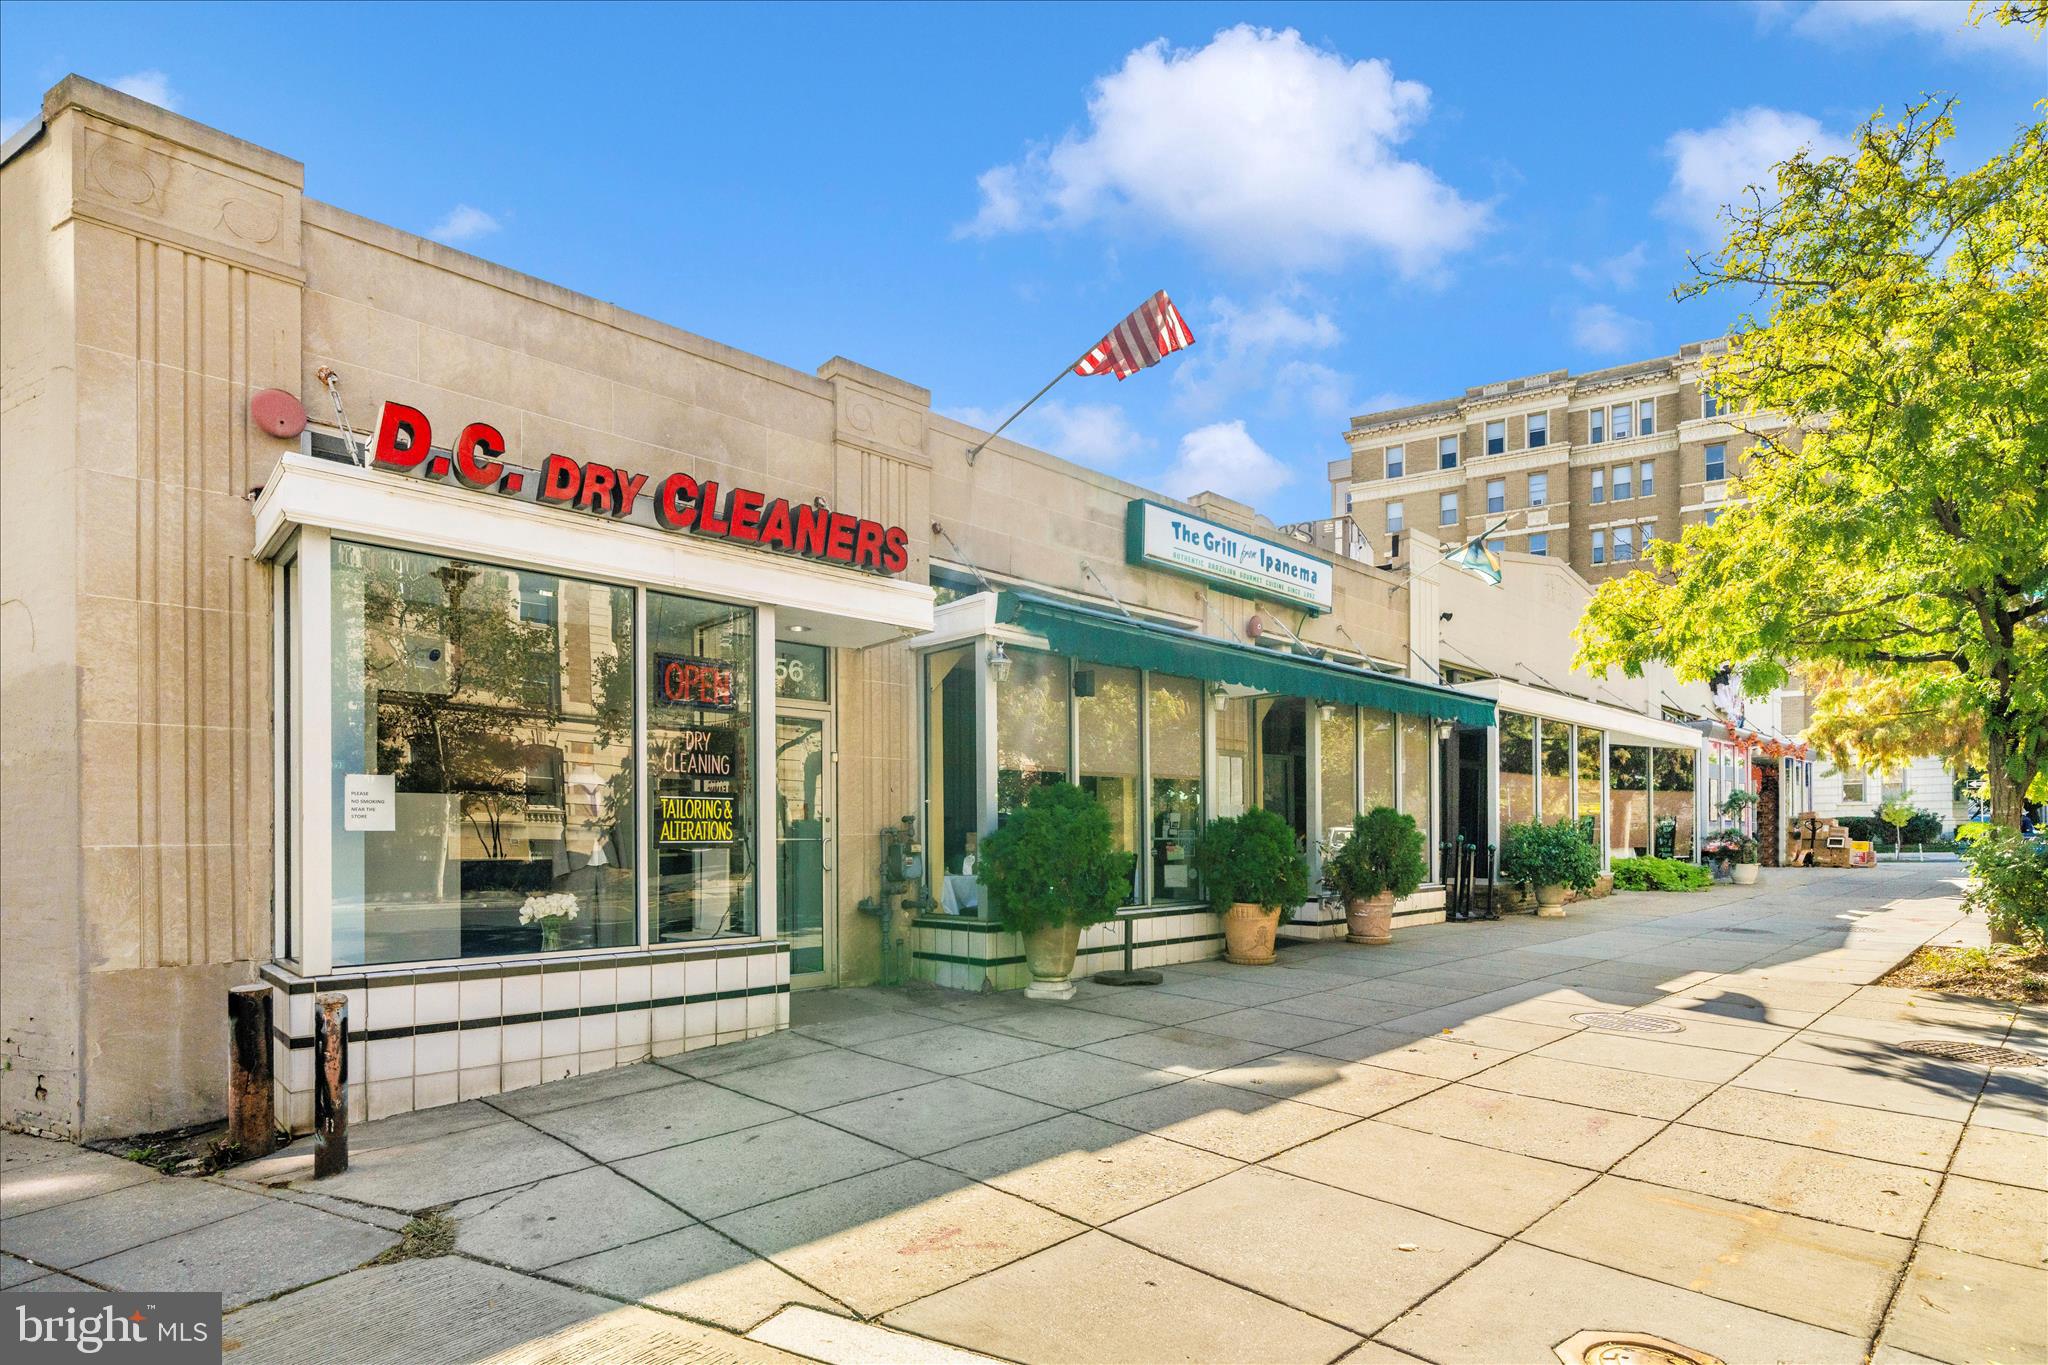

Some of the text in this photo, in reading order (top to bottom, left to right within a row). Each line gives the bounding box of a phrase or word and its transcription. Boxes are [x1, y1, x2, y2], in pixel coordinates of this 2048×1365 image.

[371, 400, 909, 574] D.C. DRY CLEANERS
[1171, 521, 1318, 585] The Grill from Ipanema
[1173, 551, 1204, 567] AUTHENTIC
[1208, 562, 1236, 576] BRAZILIAN
[1240, 570, 1262, 584] GOURMET
[1265, 579, 1284, 591] CUISINE
[664, 662, 731, 705] OPEN
[686, 731, 711, 751] DRY
[665, 752, 730, 775] CLEANING
[660, 798, 733, 820] TAILORING &
[660, 820, 733, 841] ALTERATIONS
